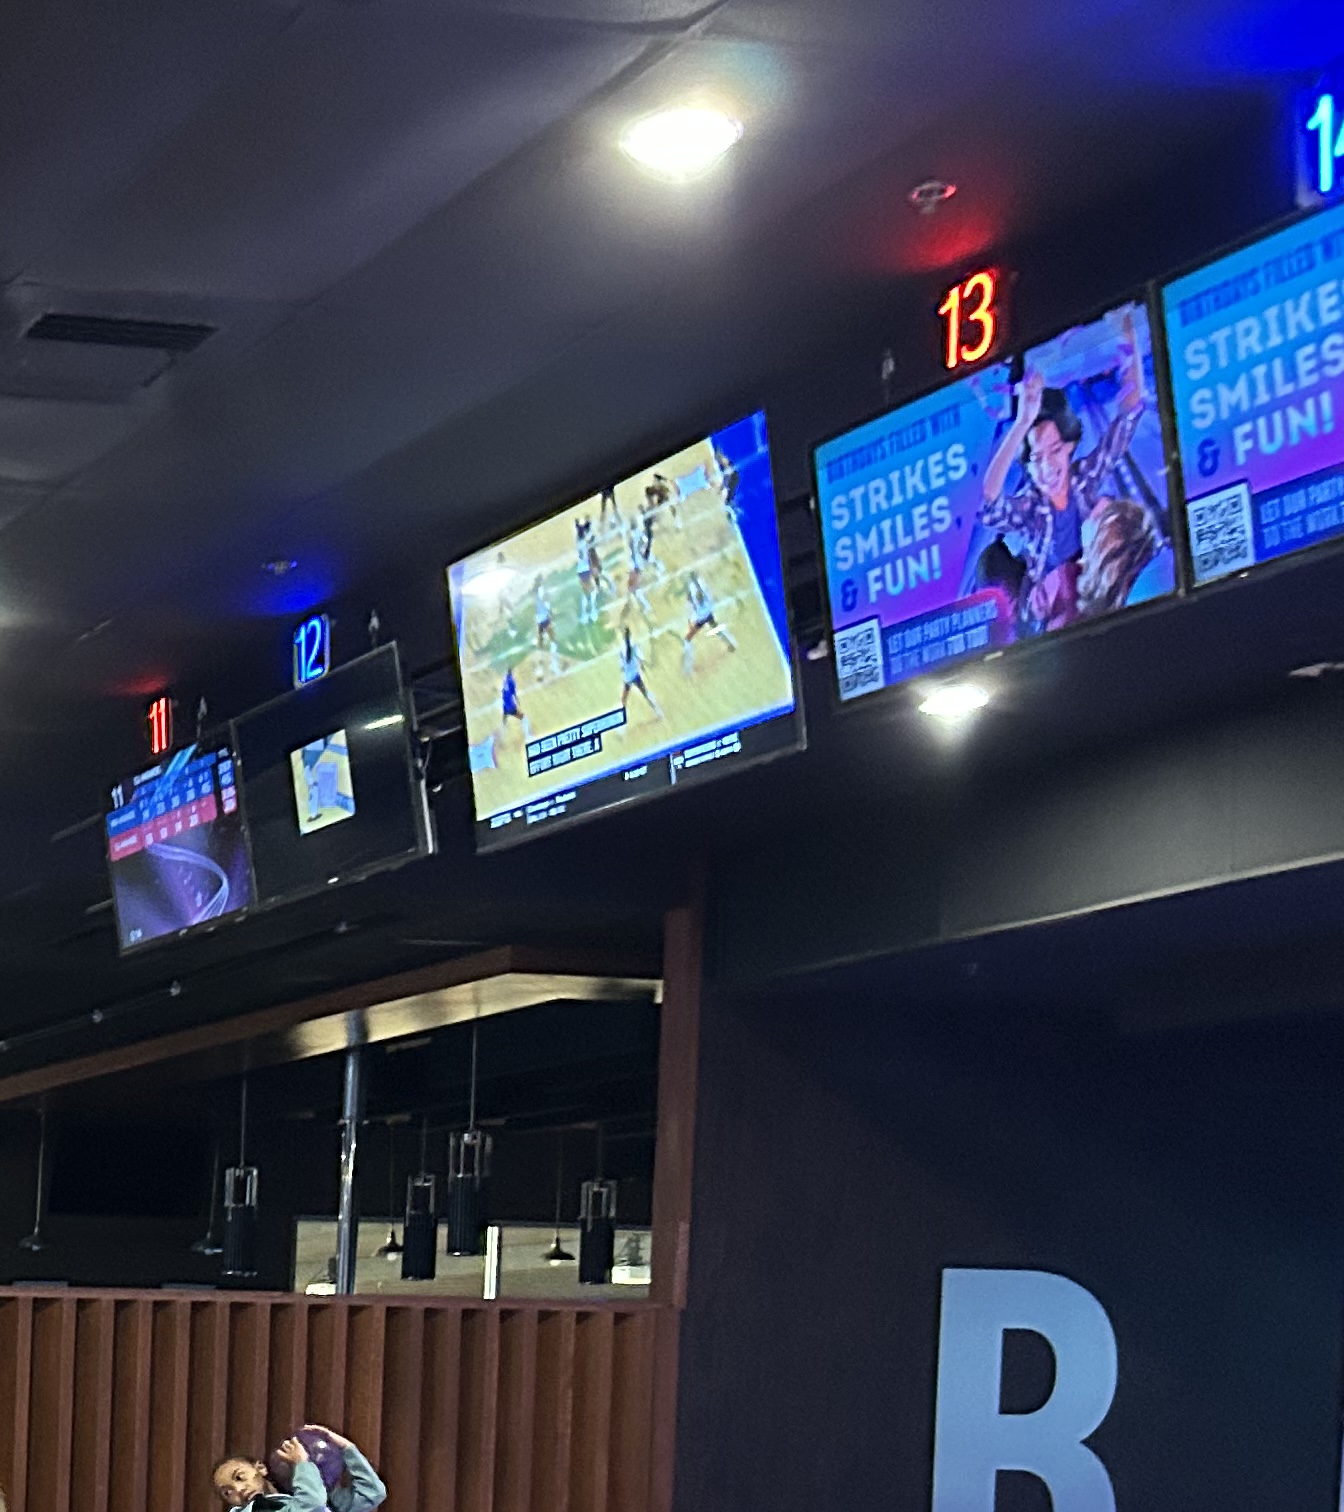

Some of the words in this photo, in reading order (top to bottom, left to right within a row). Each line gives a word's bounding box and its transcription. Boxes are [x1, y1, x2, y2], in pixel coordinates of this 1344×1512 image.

[1306, 93, 1344, 192] 1
[938, 268, 997, 369] 13
[1184, 278, 1344, 382] STRIKE
[1197, 438, 1221, 478] &
[1231, 390, 1336, 467] FUN!
[840, 578, 859, 613] &
[866, 544, 942, 604] FUN!
[296, 615, 324, 683] 12
[148, 697, 167, 753] 11
